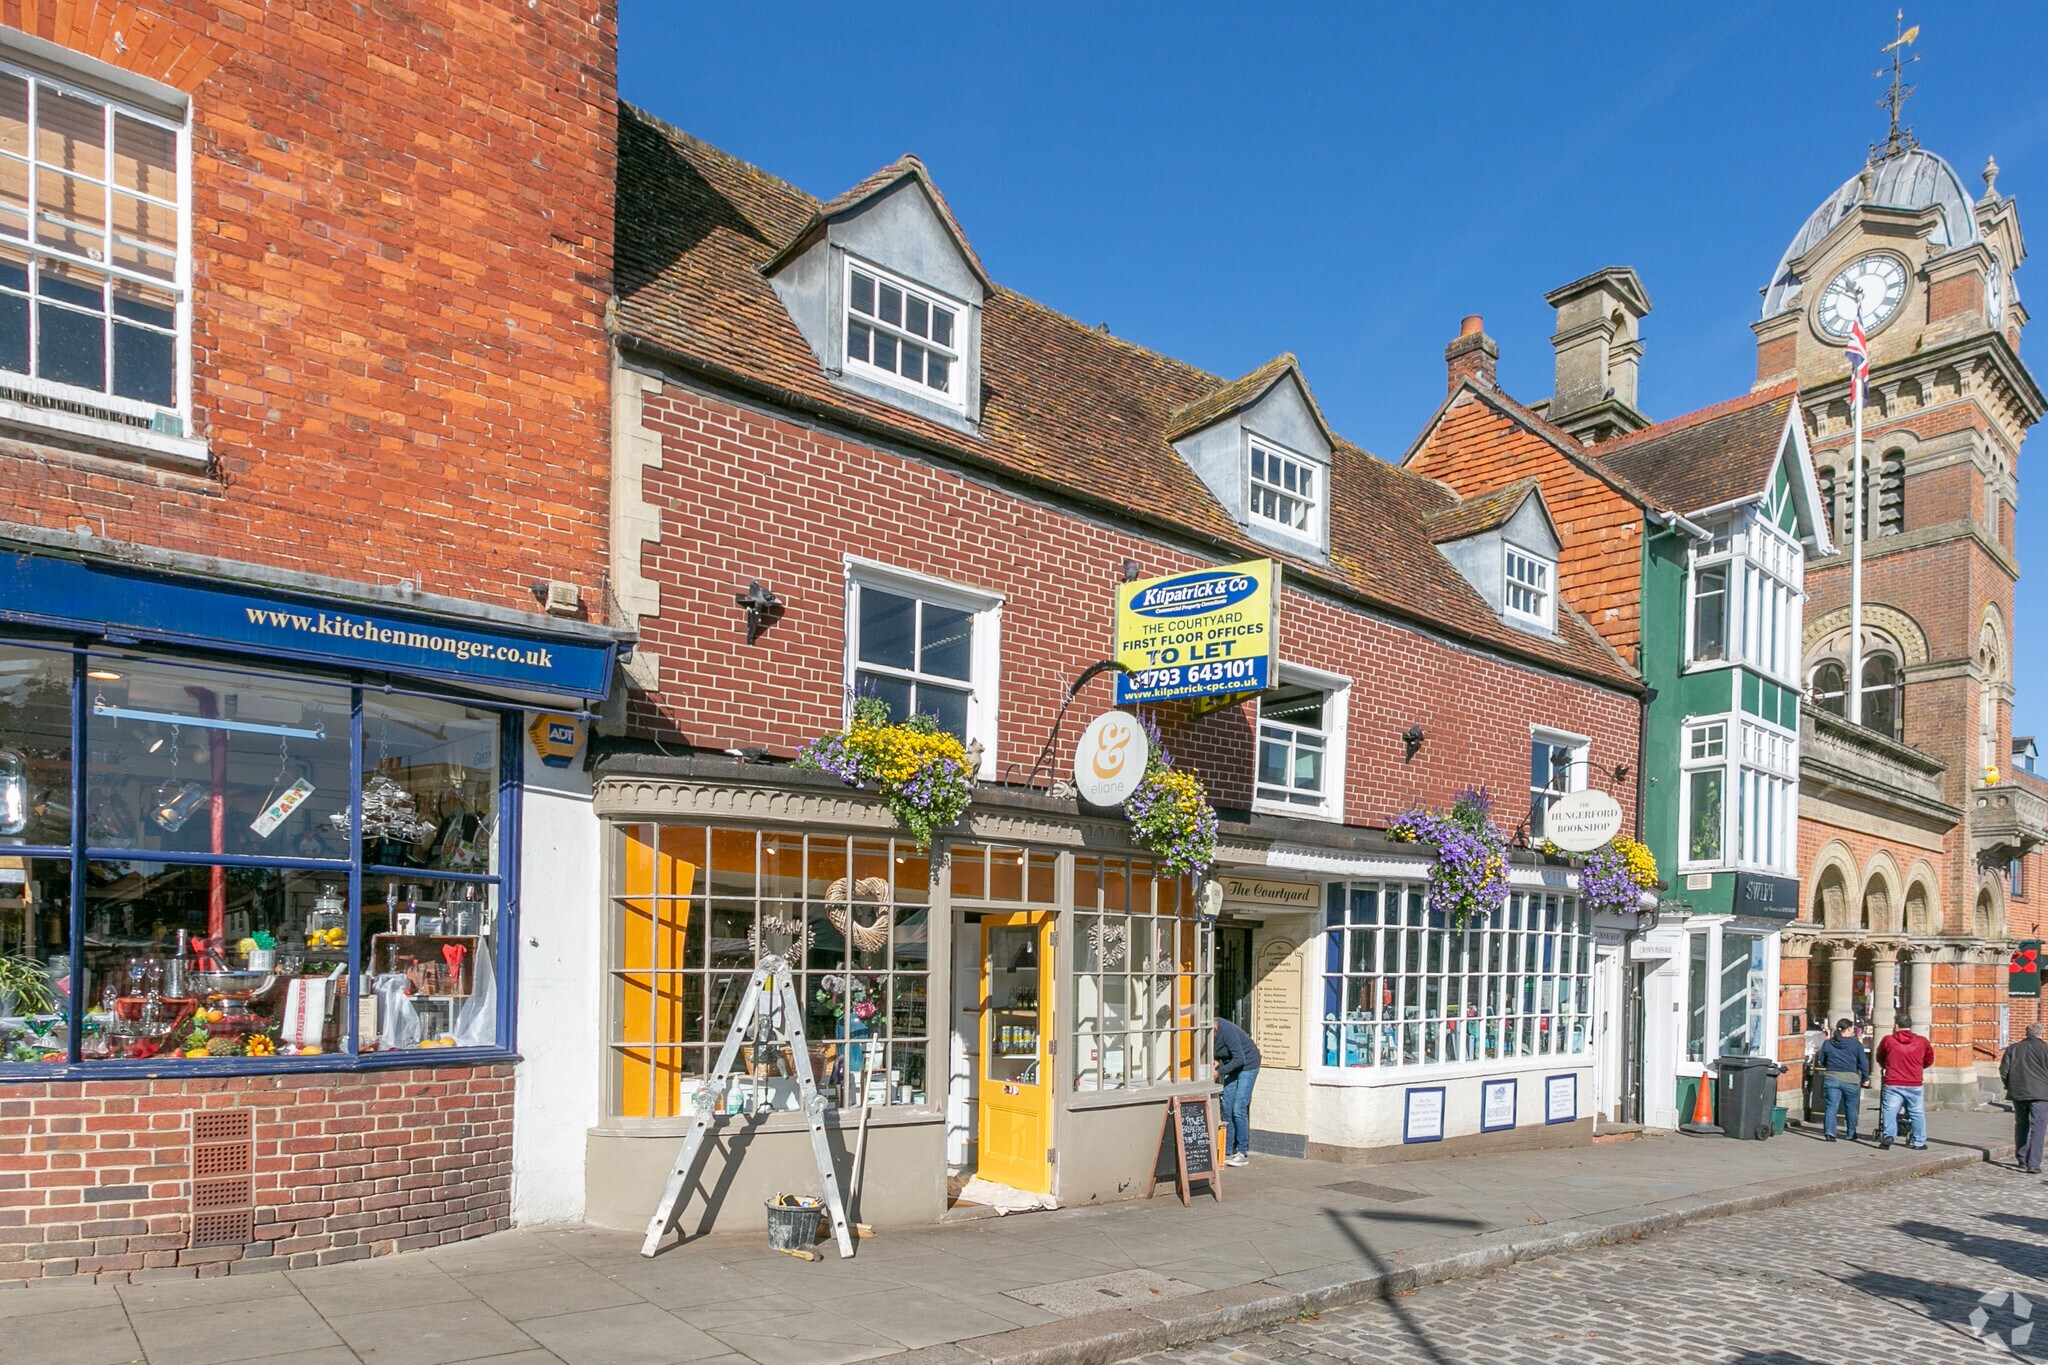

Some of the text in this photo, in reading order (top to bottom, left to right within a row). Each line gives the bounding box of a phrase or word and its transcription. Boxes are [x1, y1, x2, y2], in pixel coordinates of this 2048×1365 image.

[1143, 578, 1248, 606] Kilpatrick & Co
[1155, 605, 1181, 614] Commercial
[1181, 602, 1200, 611] Property
[1143, 612, 1242, 635] THE COURTYARD
[245, 607, 552, 667] www.kitchenmonger.co.uk
[1123, 623, 1264, 651] FIRST FLOOR OFFICES
[1146, 640, 1236, 665] TO LET
[1188, 659, 1254, 683] 643101
[1124, 677, 1258, 700] www.kilpatrick-cpc.co.uk
[549, 728, 574, 742] ADT
[1091, 782, 1124, 795] eliane
[1551, 809, 1618, 821] HUNGERFORD
[1557, 823, 1610, 833] BOOKSHOP
[1228, 881, 1310, 902] The Courtyard
[1745, 881, 1774, 902] SWIFT
[1185, 1115, 1205, 1125] POWER
